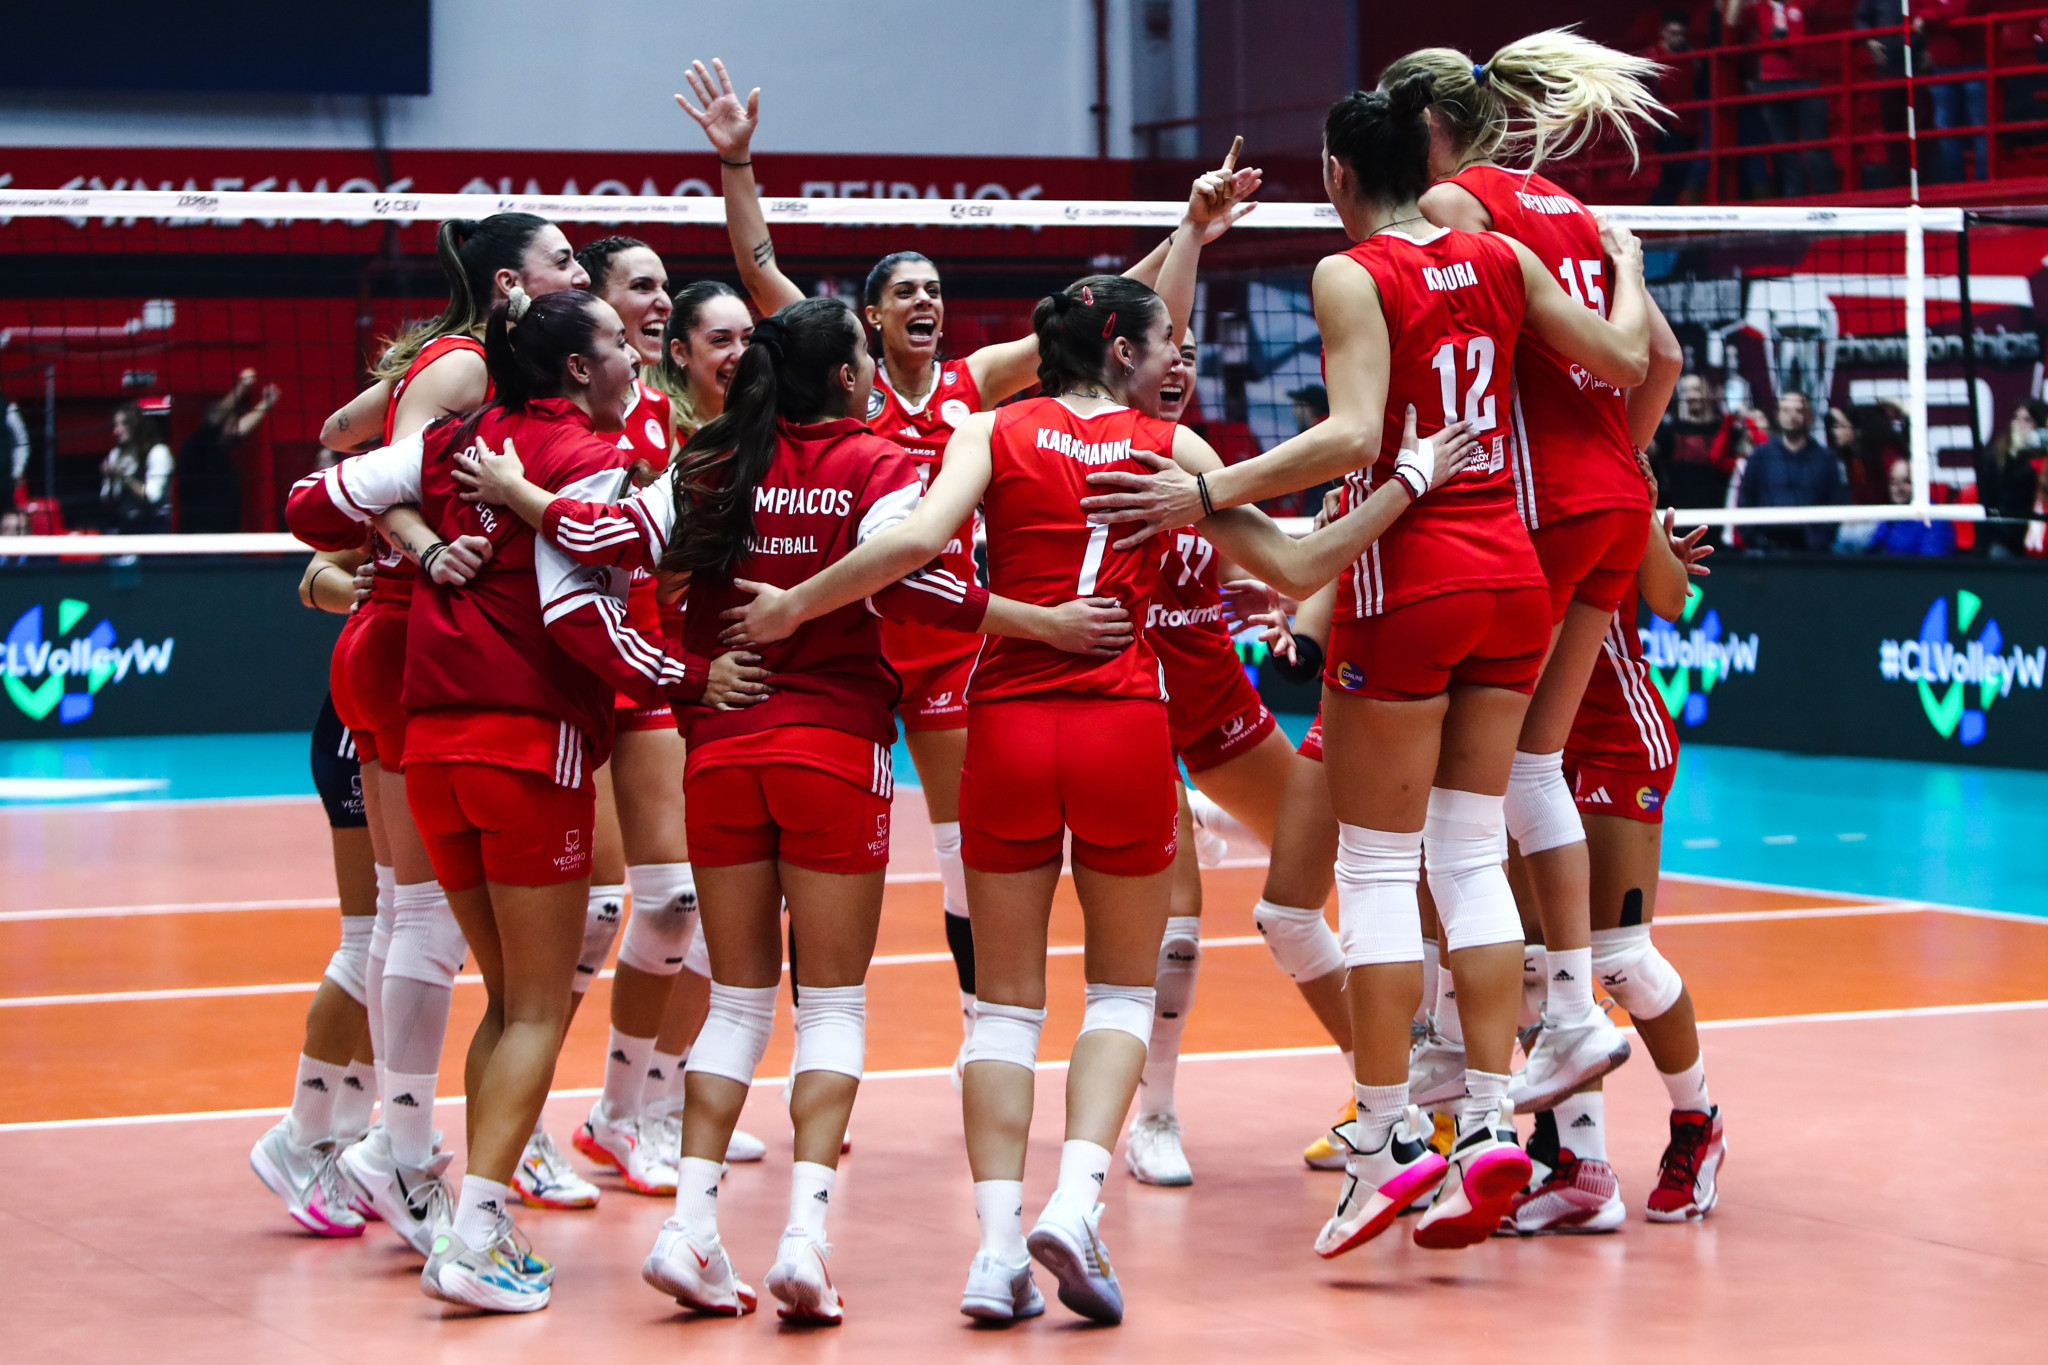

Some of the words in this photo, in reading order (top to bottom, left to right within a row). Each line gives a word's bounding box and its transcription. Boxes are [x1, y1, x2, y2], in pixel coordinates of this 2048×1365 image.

[969, 205, 993, 216] CEV
[1558, 257, 1607, 322] 15
[1431, 335, 1497, 432] 12
[1036, 427, 1132, 466] KARAGIANNI
[752, 486, 853, 517] MPIACOS
[1176, 533, 1213, 586] 77
[1878, 638, 2047, 698] #CLVolleyW
